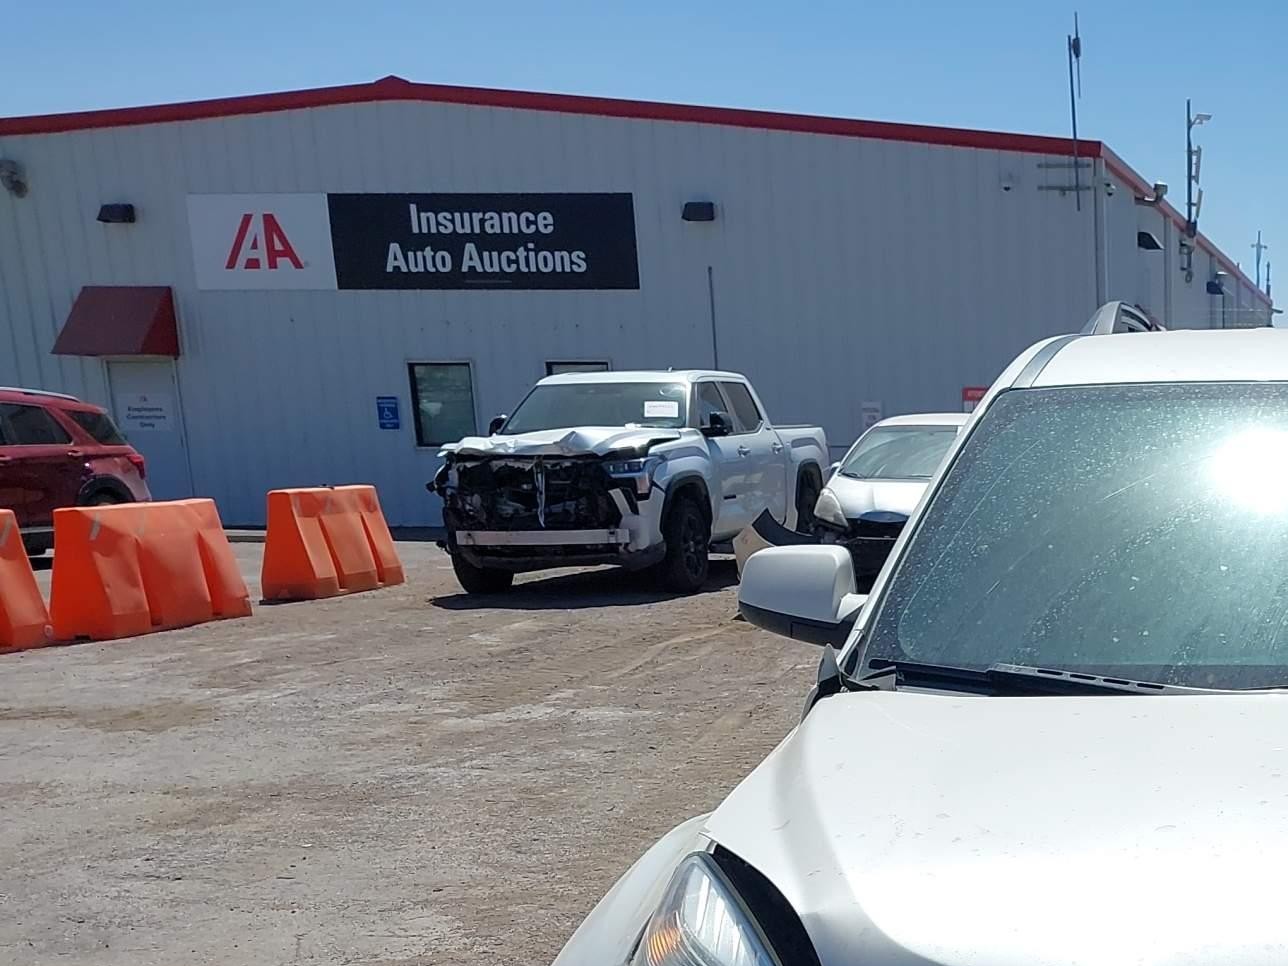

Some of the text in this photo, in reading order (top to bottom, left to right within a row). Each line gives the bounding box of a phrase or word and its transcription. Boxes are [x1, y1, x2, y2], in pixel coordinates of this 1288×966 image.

[410, 203, 554, 234] Insurance
[386, 242, 587, 273] Auto Auctions
